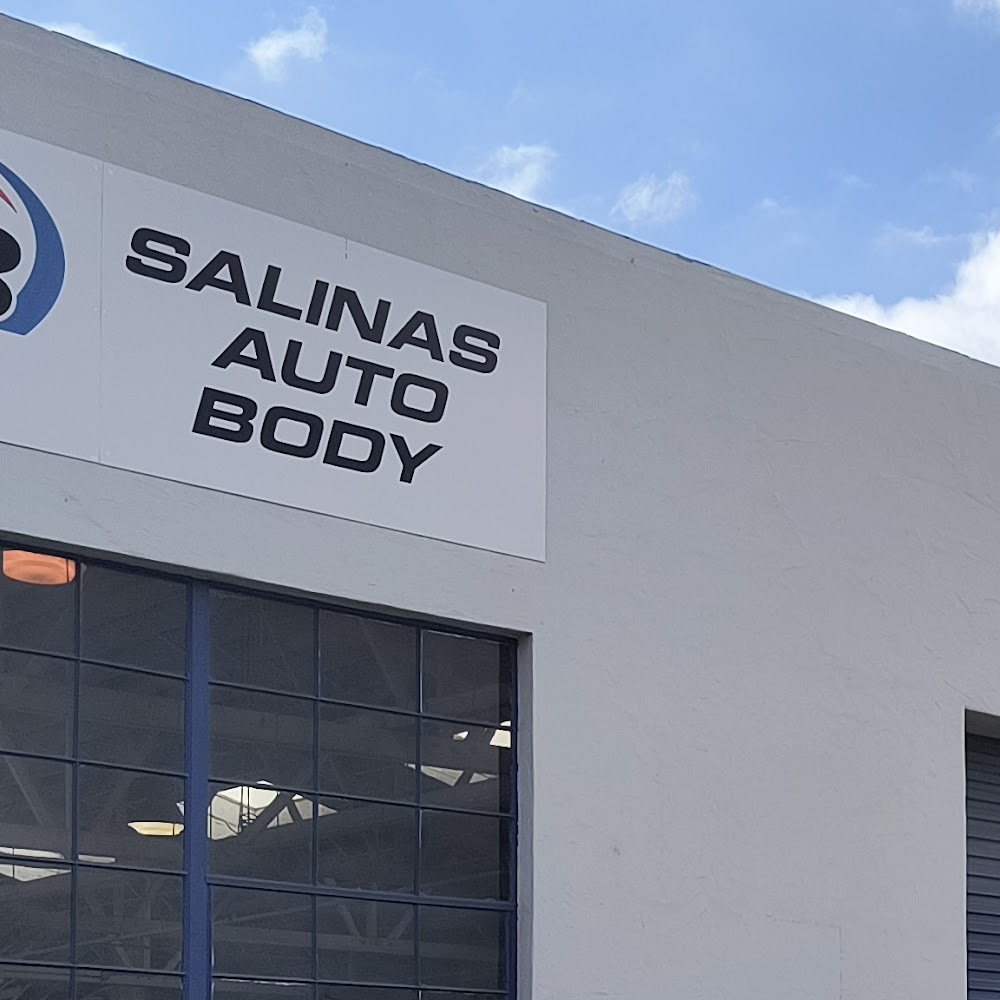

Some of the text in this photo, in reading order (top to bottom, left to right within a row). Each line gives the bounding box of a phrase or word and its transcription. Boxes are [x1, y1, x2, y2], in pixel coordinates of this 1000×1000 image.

[126, 227, 500, 374] SALINAS
[211, 327, 449, 423] AUTO
[192, 387, 443, 484] BODY
